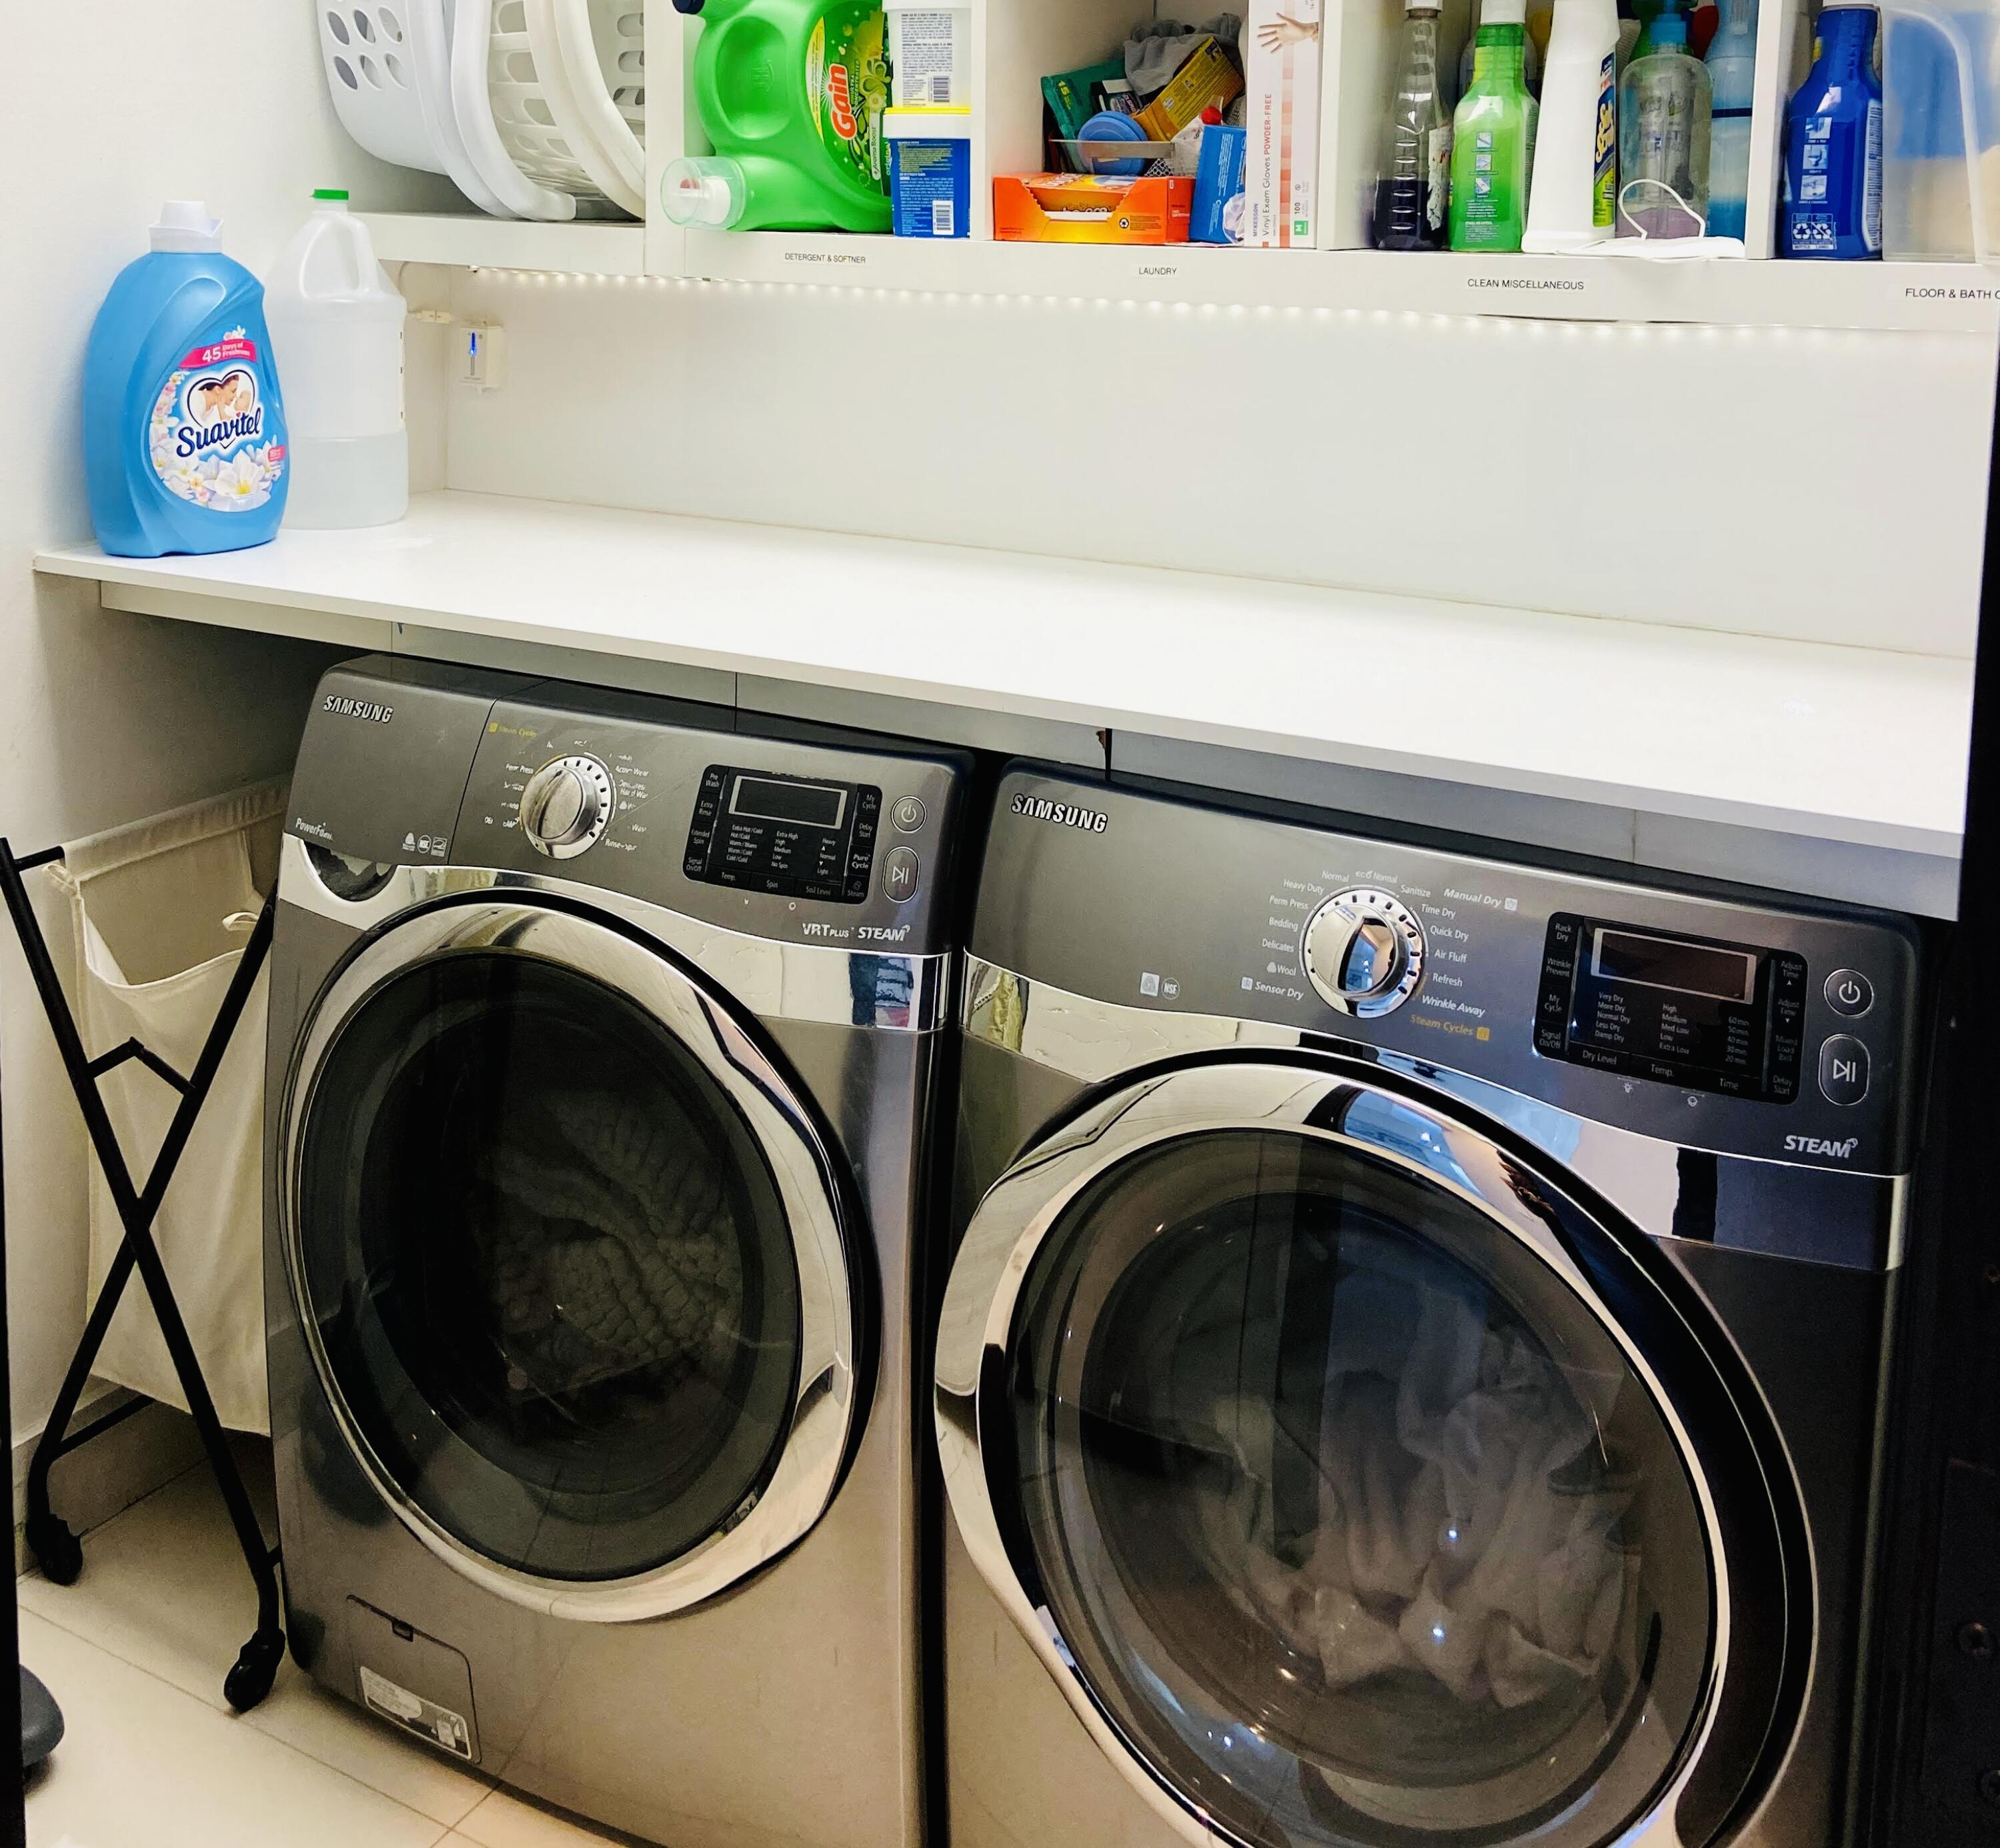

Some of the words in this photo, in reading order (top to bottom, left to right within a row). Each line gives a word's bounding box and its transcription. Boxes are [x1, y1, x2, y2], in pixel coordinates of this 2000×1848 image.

[828, 64, 857, 139] Gain
[1263, 93, 1272, 155] POWDER-FREE
[1262, 157, 1270, 188] Gloves
[1262, 190, 1270, 213] Exam
[1262, 214, 1270, 235] Vinyl
[785, 253, 825, 261] DETERGENT
[1139, 267, 1176, 275] LAUNDRY
[1467, 279, 1499, 287] CLEAN
[1502, 279, 1584, 290] MISCELLANEOUS
[1905, 288, 1945, 297] FLOOR
[1949, 289, 1956, 298] &
[1960, 289, 1991, 299] BATH
[202, 346, 221, 362] 45
[176, 407, 261, 457] Suavitel
[323, 694, 393, 723] SAMSUNG
[706, 780, 720, 788] Wash
[700, 800, 713, 809] Extra
[866, 794, 875, 803] My
[862, 802, 876, 810] Cycle
[699, 808, 712, 817] Rinse
[1011, 794, 1108, 832] SAMSUNG
[859, 823, 873, 832] Delay
[788, 832, 798, 840] High
[859, 830, 871, 838] Start
[822, 838, 836, 846] Heavy
[774, 846, 792, 854] Medium
[688, 857, 702, 866] Signal
[820, 853, 836, 861] Normal
[852, 861, 869, 870] Cycle
[817, 868, 828, 876] Light
[1322, 870, 1350, 882] Normal
[1373, 872, 1398, 884] Normal
[766, 880, 778, 890] Spin
[806, 886, 816, 894] Soil
[816, 887, 831, 896] Level
[1283, 879, 1306, 892] Heavy
[1307, 883, 1324, 895] Duty
[847, 889, 864, 897] Steam
[1400, 885, 1431, 898] Sanitize
[1269, 895, 1288, 906] Perm
[1289, 900, 1308, 910] Press
[1443, 888, 1482, 902] Manual
[1483, 896, 1503, 908] Dry
[1421, 903, 1440, 916] Time
[1441, 908, 1456, 920] Dry
[1269, 916, 1298, 932] Bedding
[1555, 923, 1573, 932] Rack
[858, 926, 905, 941] STEAM
[1430, 925, 1453, 938] Quick
[1454, 930, 1469, 942] Dry
[1557, 932, 1569, 942] Dry
[1262, 938, 1294, 953] Delicates
[1434, 948, 1446, 959] Air
[1448, 952, 1467, 963] Fluff
[1547, 957, 1572, 969] Wrinkle
[1781, 960, 1802, 972] Adjust
[1277, 964, 1296, 976] Wool
[1546, 966, 1570, 978] Prevent
[1783, 969, 1799, 978] Time
[1432, 973, 1463, 987] Refresh
[1164, 982, 1178, 994] NSF
[1254, 982, 1286, 995] Sensor
[1286, 988, 1304, 1000] Dry
[1549, 994, 1560, 1003] My
[1599, 992, 1612, 1001] Very
[1613, 994, 1624, 1003] Dry
[1422, 994, 1456, 1010] Wrinkle
[1457, 1002, 1486, 1018] Away
[1544, 1002, 1562, 1012] Cycle
[1598, 1001, 1613, 1010] More
[1615, 1004, 1626, 1014] Dry
[1663, 1003, 1677, 1014] High
[1781, 1007, 1797, 1016] Time
[1597, 1010, 1619, 1021] Normal
[1621, 1014, 1631, 1024] Dry
[1662, 1014, 1687, 1024] Medium
[1410, 1014, 1440, 1029] Steam
[1443, 1022, 1474, 1036] Cycles
[1596, 1020, 1609, 1029] Less
[1609, 1022, 1621, 1032] Dry
[1661, 1023, 1675, 1032] Med
[1676, 1026, 1689, 1034] Low
[1541, 1029, 1561, 1040] Signal
[1595, 1030, 1613, 1040] Damp
[1614, 1033, 1625, 1042] Dry
[1660, 1033, 1674, 1042] Low
[1539, 1038, 1561, 1049] On/Off
[1659, 1042, 1675, 1052] Extra
[1677, 1046, 1690, 1054] Low
[1583, 1050, 1596, 1062] Dry
[1597, 1052, 1617, 1065] Level
[1651, 1064, 1675, 1078] Temp.
[1720, 1078, 1739, 1090] Time
[1773, 1075, 1793, 1086] Delay
[1774, 1084, 1790, 1095] Start
[1784, 1135, 1852, 1158] STEAM
